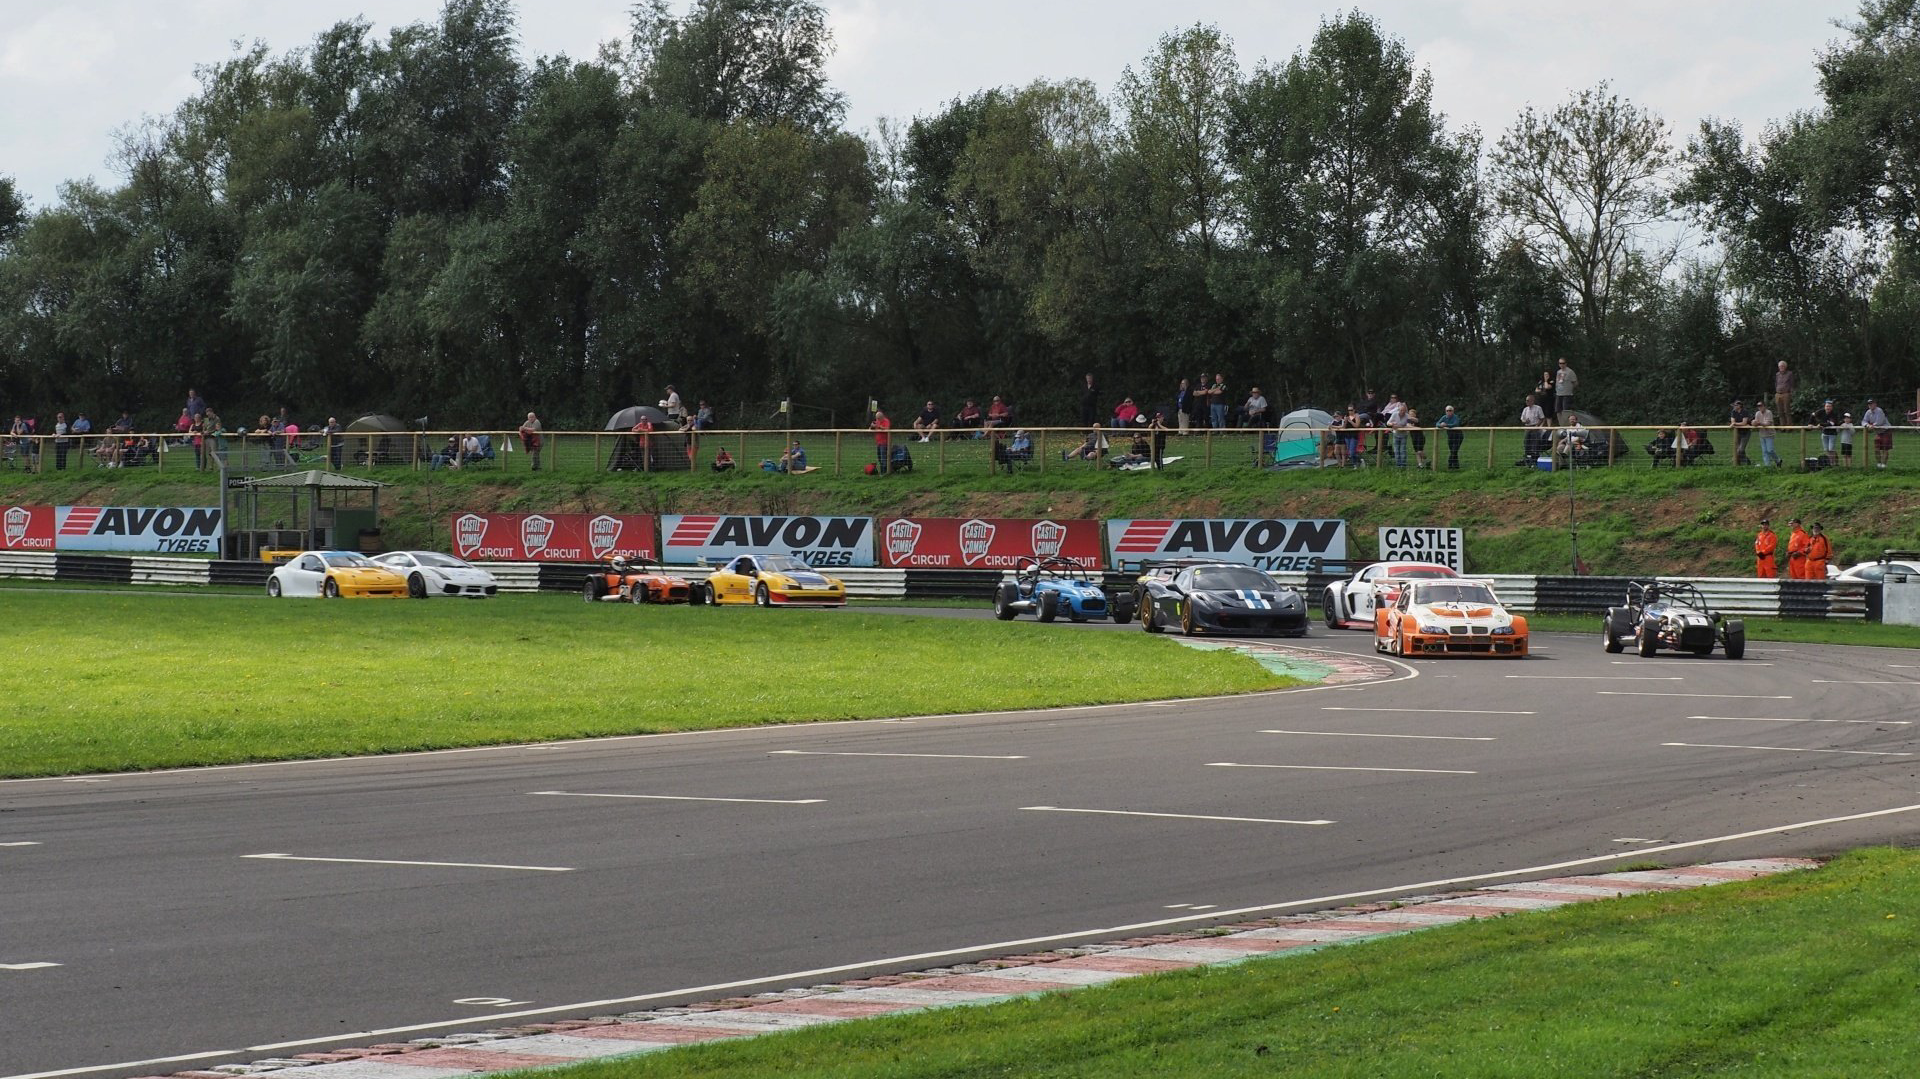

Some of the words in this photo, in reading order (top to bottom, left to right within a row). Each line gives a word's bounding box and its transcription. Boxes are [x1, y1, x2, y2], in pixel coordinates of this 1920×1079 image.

[93, 508, 221, 536] AVON
[594, 520, 614, 534] CASTLE
[709, 517, 868, 547] AVON
[891, 525, 912, 538] CASTLE
[964, 525, 987, 539] CASTLE
[1036, 526, 1058, 540] CASTLE
[1163, 520, 1340, 552] AVON
[22, 538, 52, 547] CIRCUIT
[157, 539, 209, 552] TYRES
[1385, 528, 1457, 550] CASTLE
[478, 548, 514, 557] CIRCUIT
[543, 549, 581, 558] CIRCUIT
[910, 555, 950, 565] CIRCUIT
